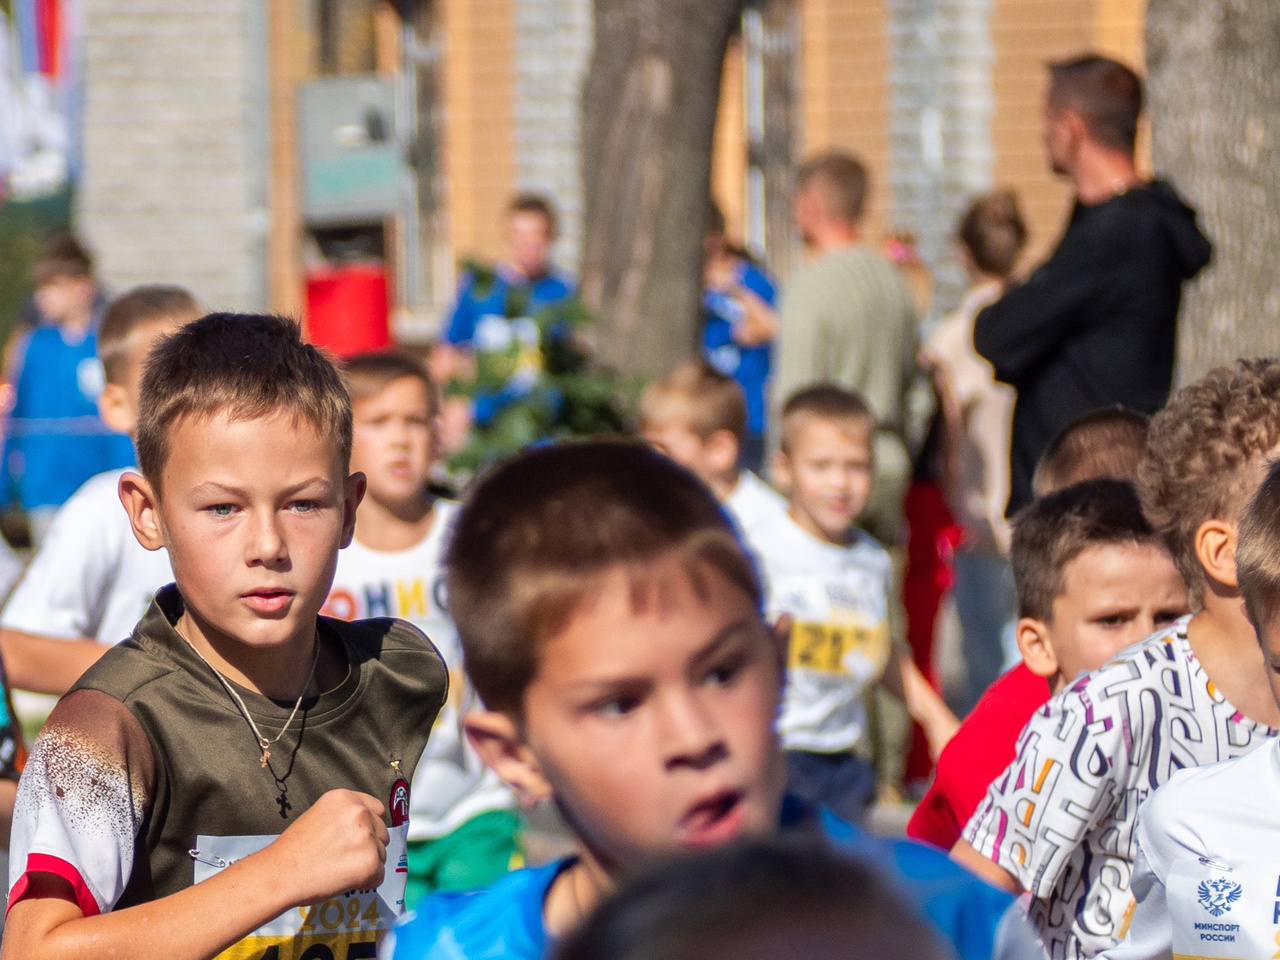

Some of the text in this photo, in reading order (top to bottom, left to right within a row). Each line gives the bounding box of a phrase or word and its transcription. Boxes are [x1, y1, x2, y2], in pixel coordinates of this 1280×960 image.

[297, 897, 380, 932] 2024
[1194, 922, 1241, 933] МИНСПОРТ
[1200, 933, 1236, 943] РОССИИ
